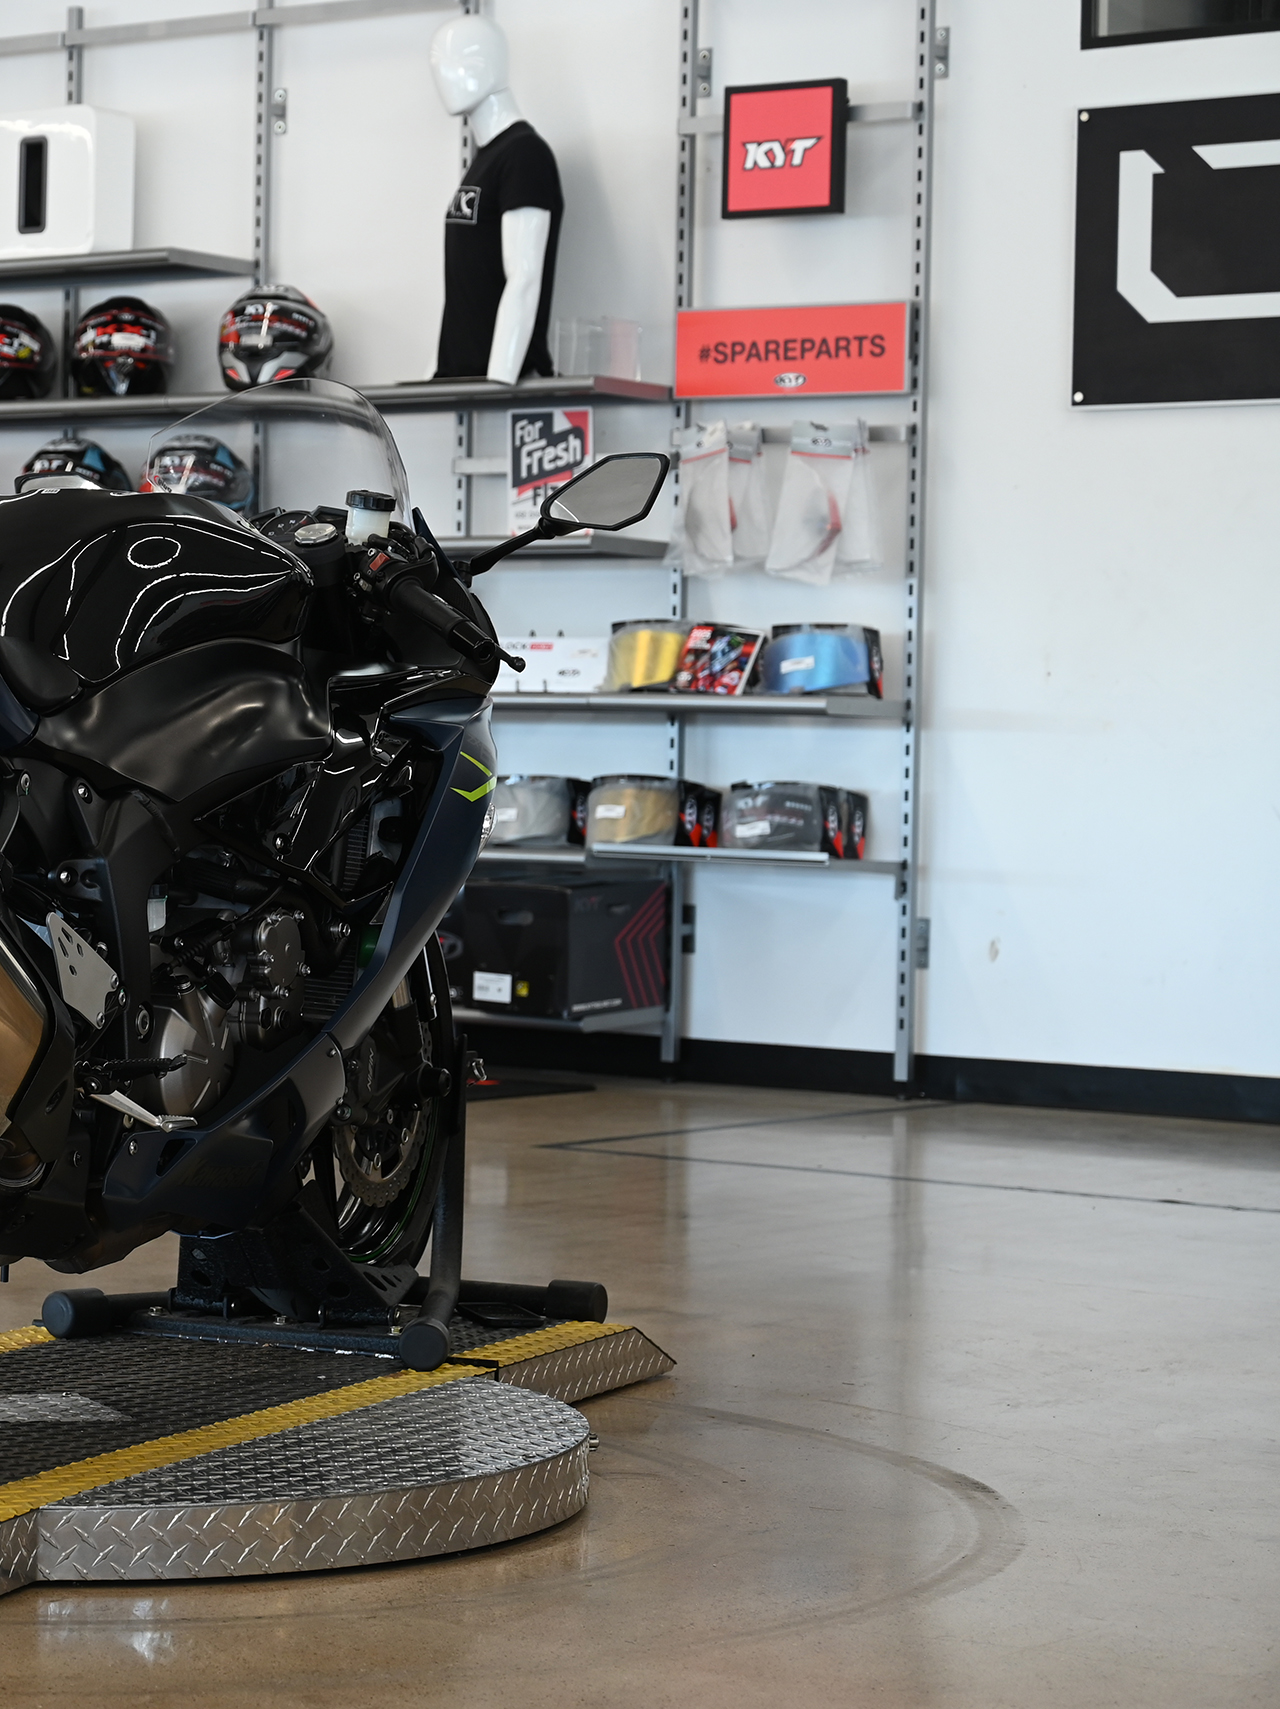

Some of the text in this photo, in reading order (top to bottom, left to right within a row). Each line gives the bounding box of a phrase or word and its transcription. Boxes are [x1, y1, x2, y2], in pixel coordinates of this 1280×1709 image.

[742, 136, 823, 170] KYT
[699, 334, 886, 363] #SPAREPARTS
[514, 419, 543, 448] For
[521, 433, 583, 479] Fresh
